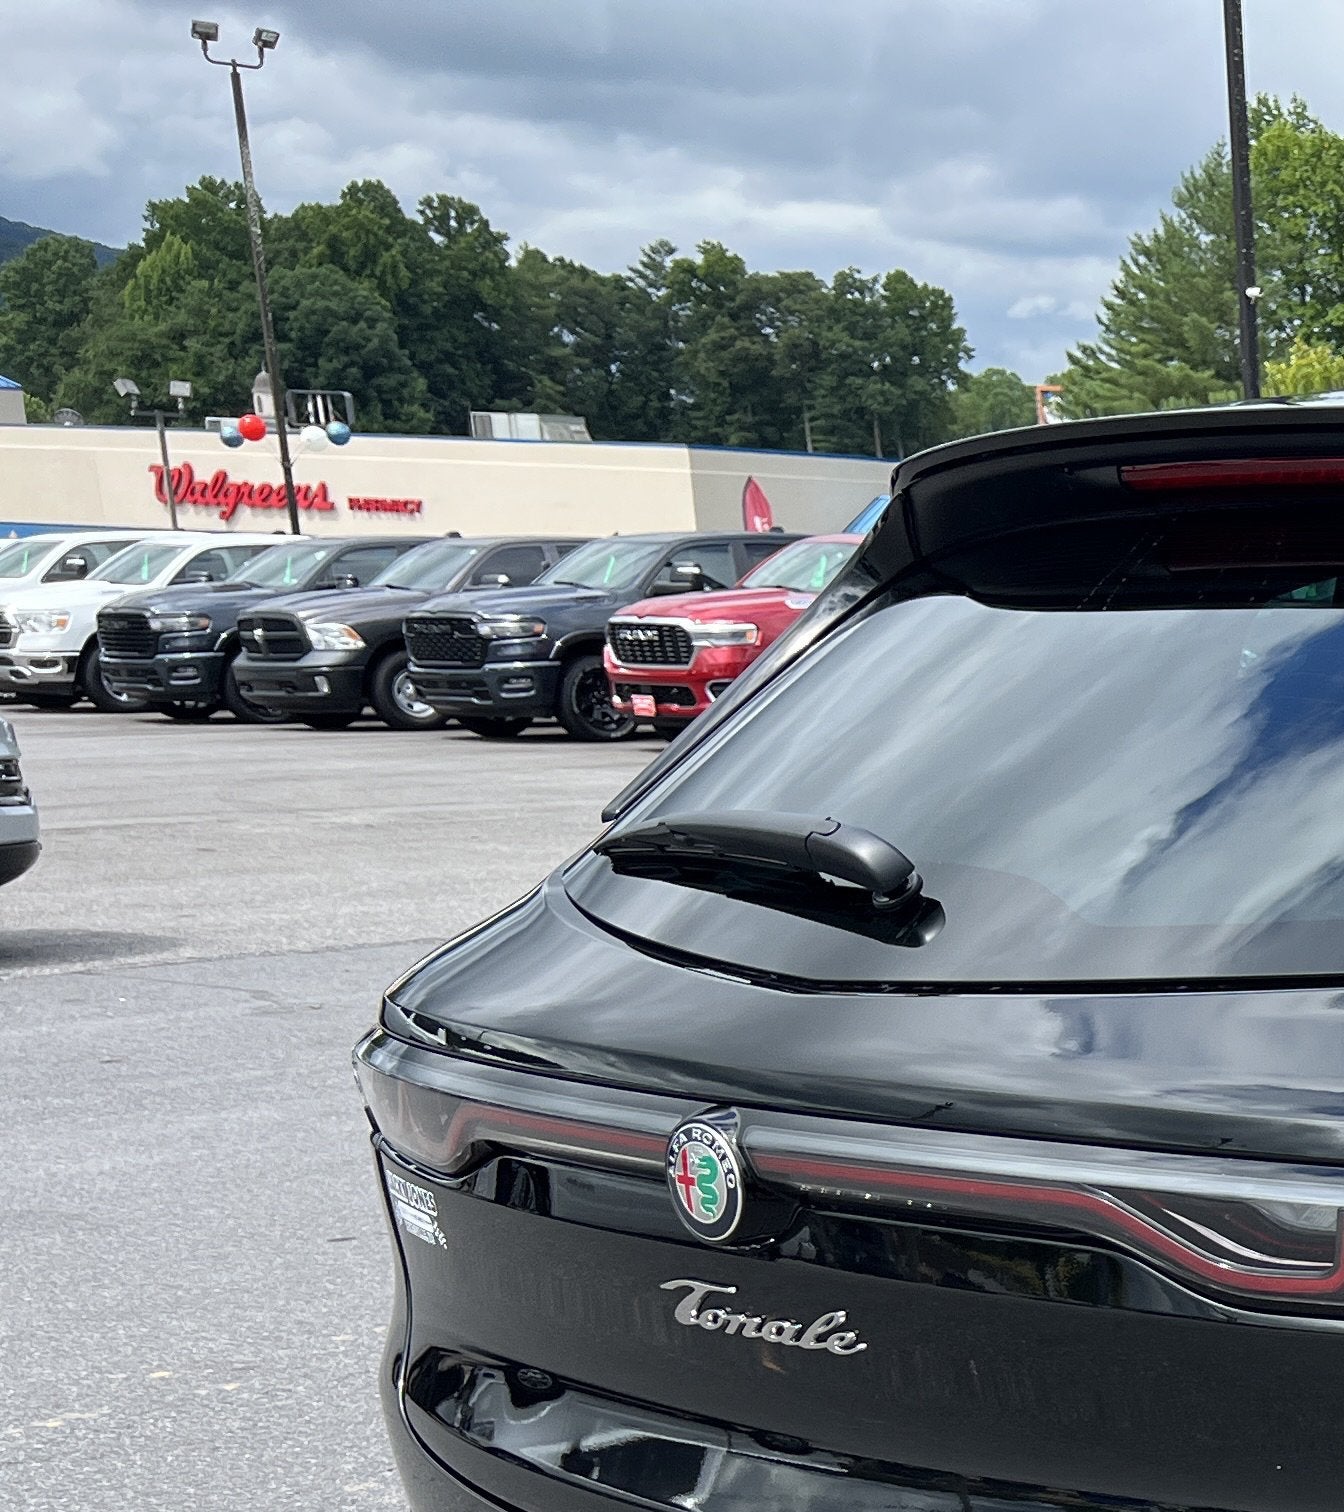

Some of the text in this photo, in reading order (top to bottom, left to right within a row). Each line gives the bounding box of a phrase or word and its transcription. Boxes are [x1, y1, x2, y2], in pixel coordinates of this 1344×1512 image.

[148, 461, 335, 521] Walgreens
[668, 1127, 736, 1189] ALFA ROMEO
[660, 1279, 868, 1356] Tonale
